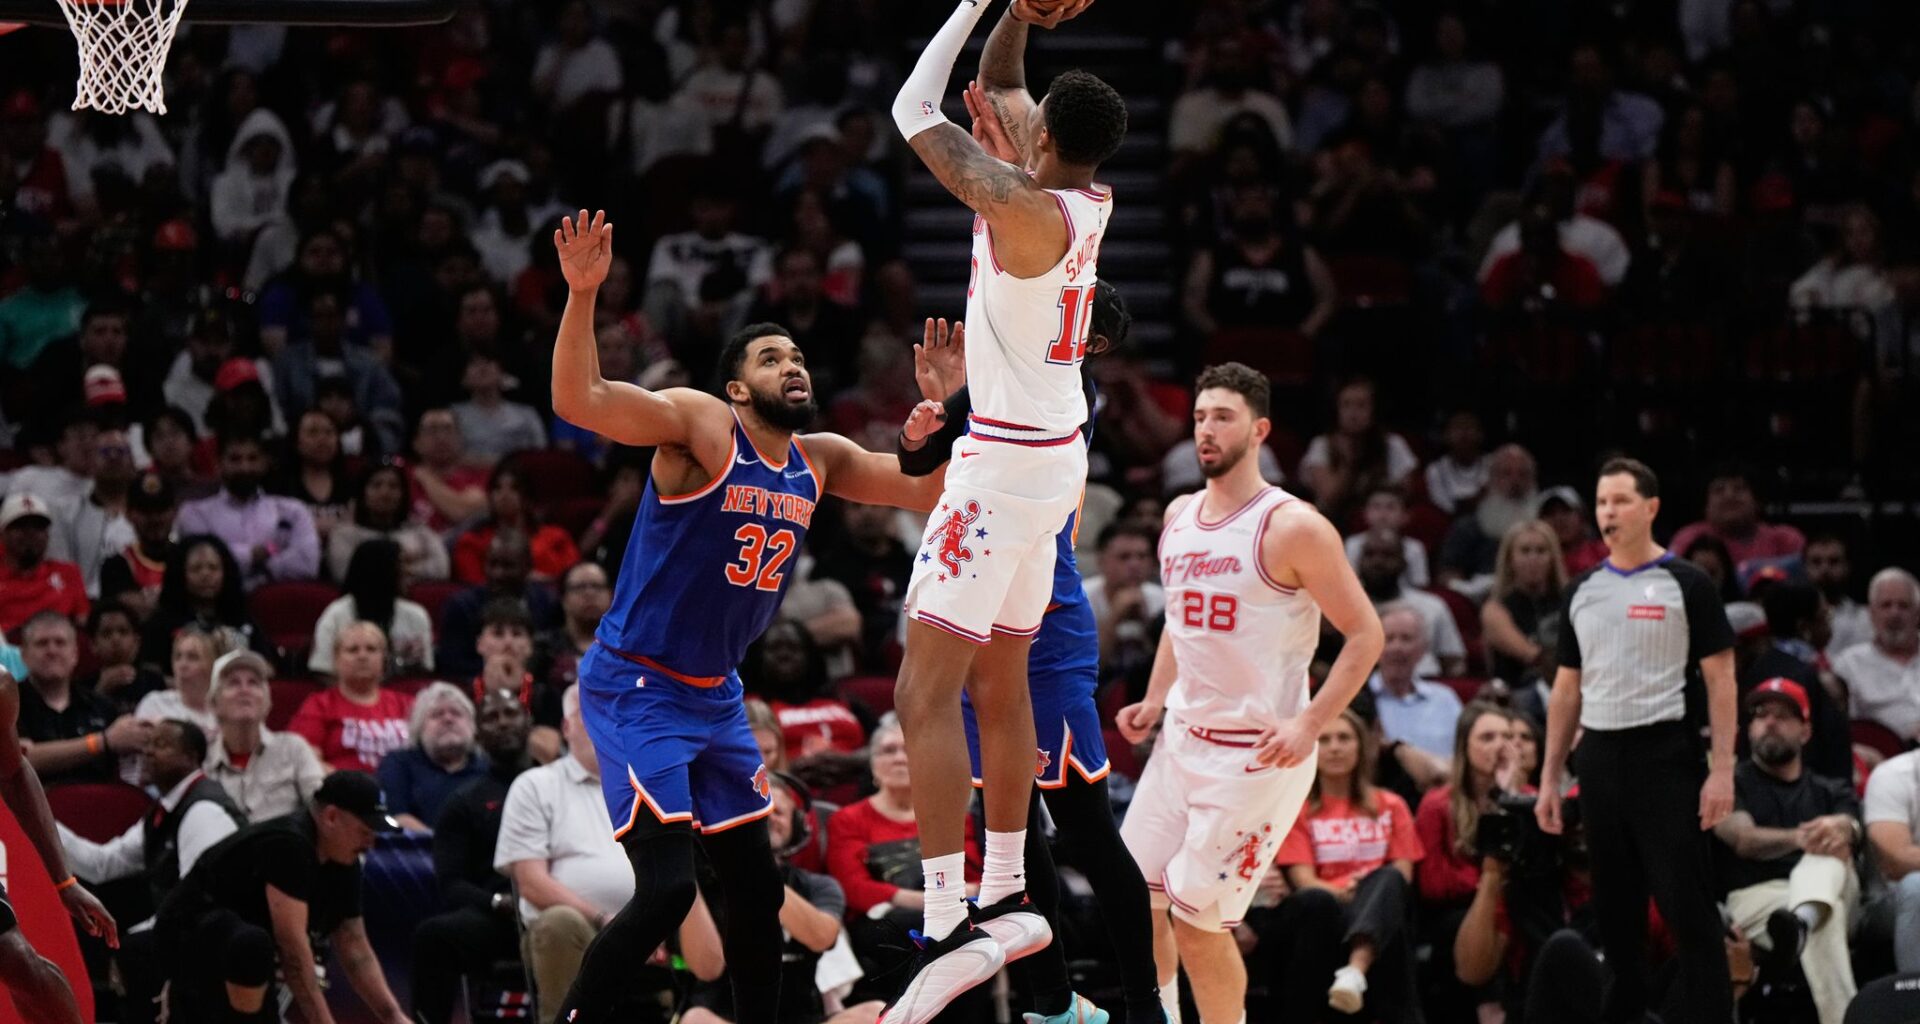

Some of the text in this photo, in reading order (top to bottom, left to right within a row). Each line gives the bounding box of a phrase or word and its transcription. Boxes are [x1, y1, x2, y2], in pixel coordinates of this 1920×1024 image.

[720, 484, 816, 530] NEW YORK
[724, 522, 796, 592] 32
[1163, 550, 1243, 587] H-Town
[1182, 588, 1240, 632] 28
